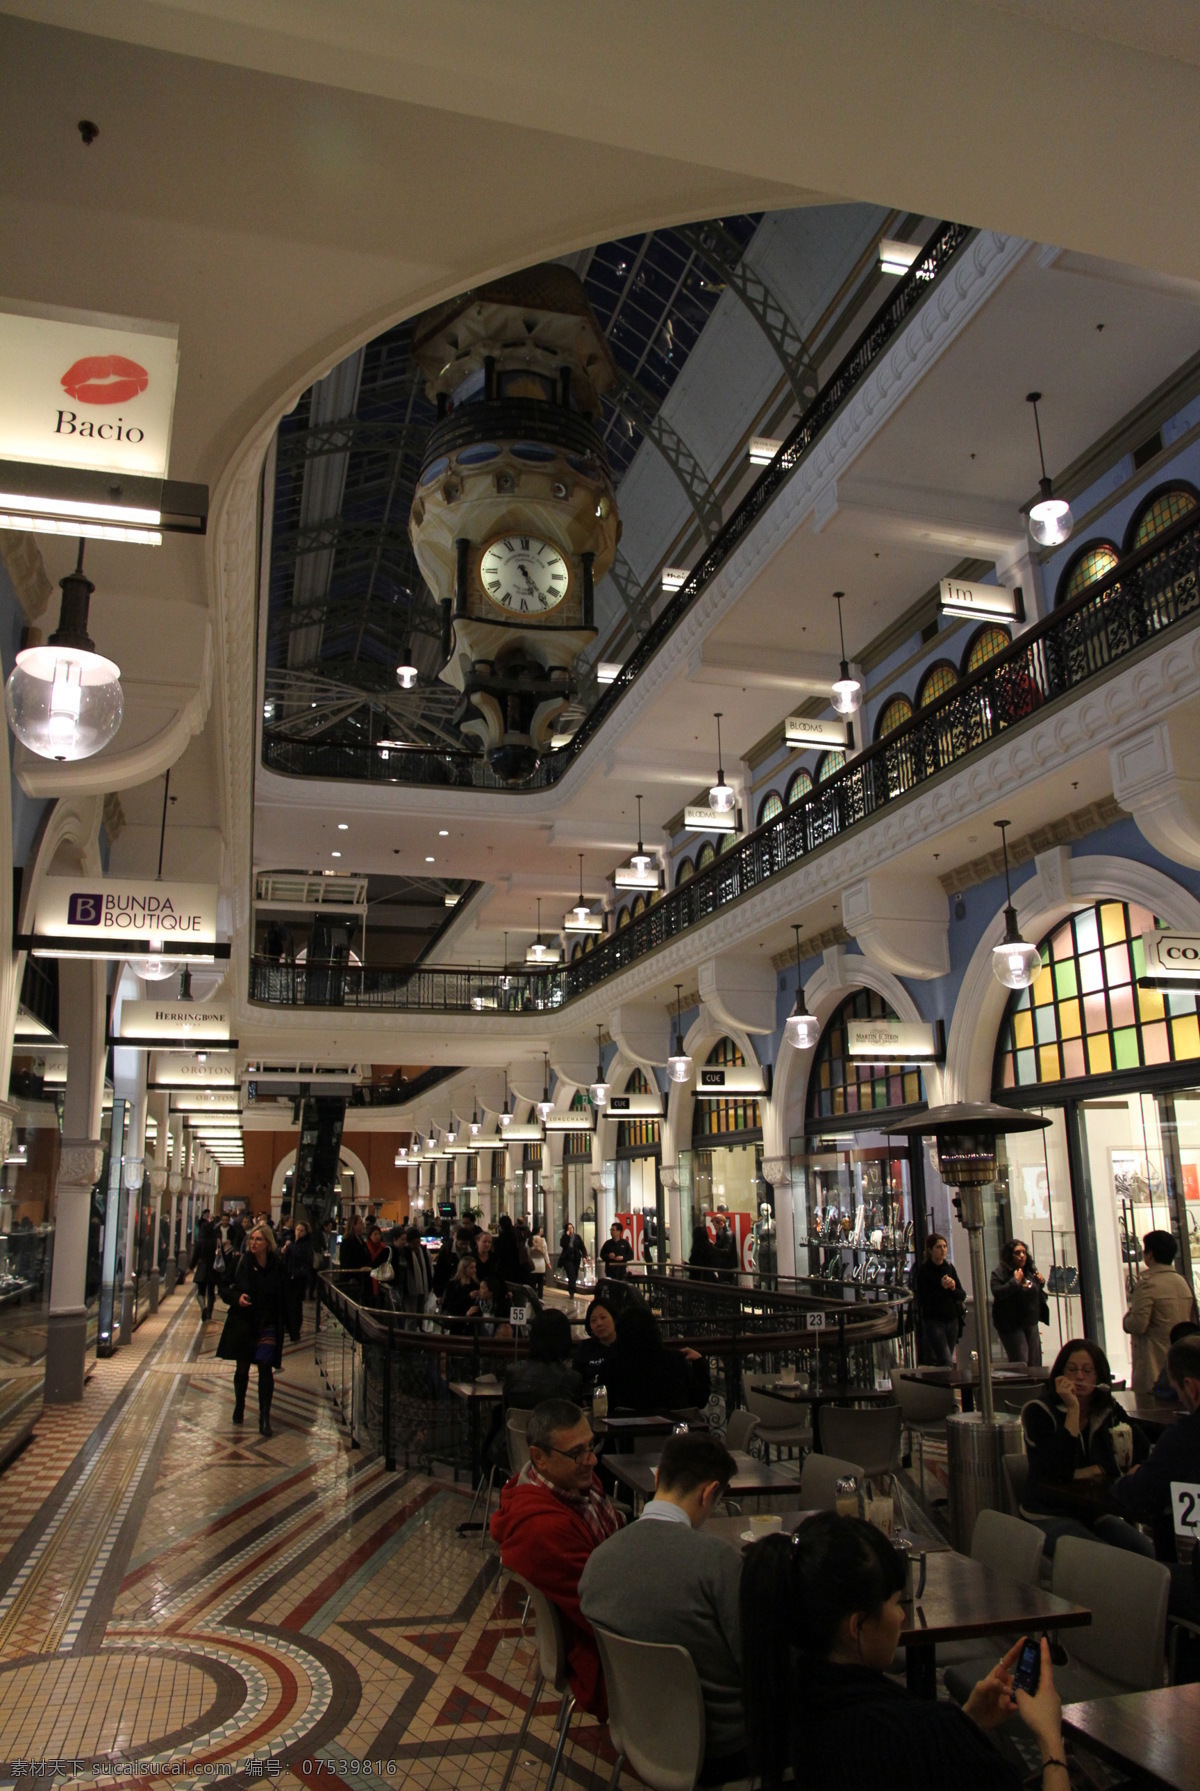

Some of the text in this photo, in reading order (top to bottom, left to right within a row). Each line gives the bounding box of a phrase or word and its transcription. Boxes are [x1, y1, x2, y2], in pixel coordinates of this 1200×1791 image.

[53, 409, 145, 444] Bacio
[947, 583, 973, 602] im
[789, 721, 823, 733] BLOOMS
[687, 809, 717, 819] BLOOMS
[105, 894, 174, 913] BUNDA
[103, 911, 202, 932] BOUTIQUE
[1166, 947, 1200, 960] CO
[181, 1065, 232, 1075] OROTON
[706, 1074, 721, 1083] CUE
[613, 1099, 627, 1107] CUE
[512, 1308, 524, 1321] 55
[809, 1314, 823, 1326] 23
[1178, 1491, 1200, 1528] 2
